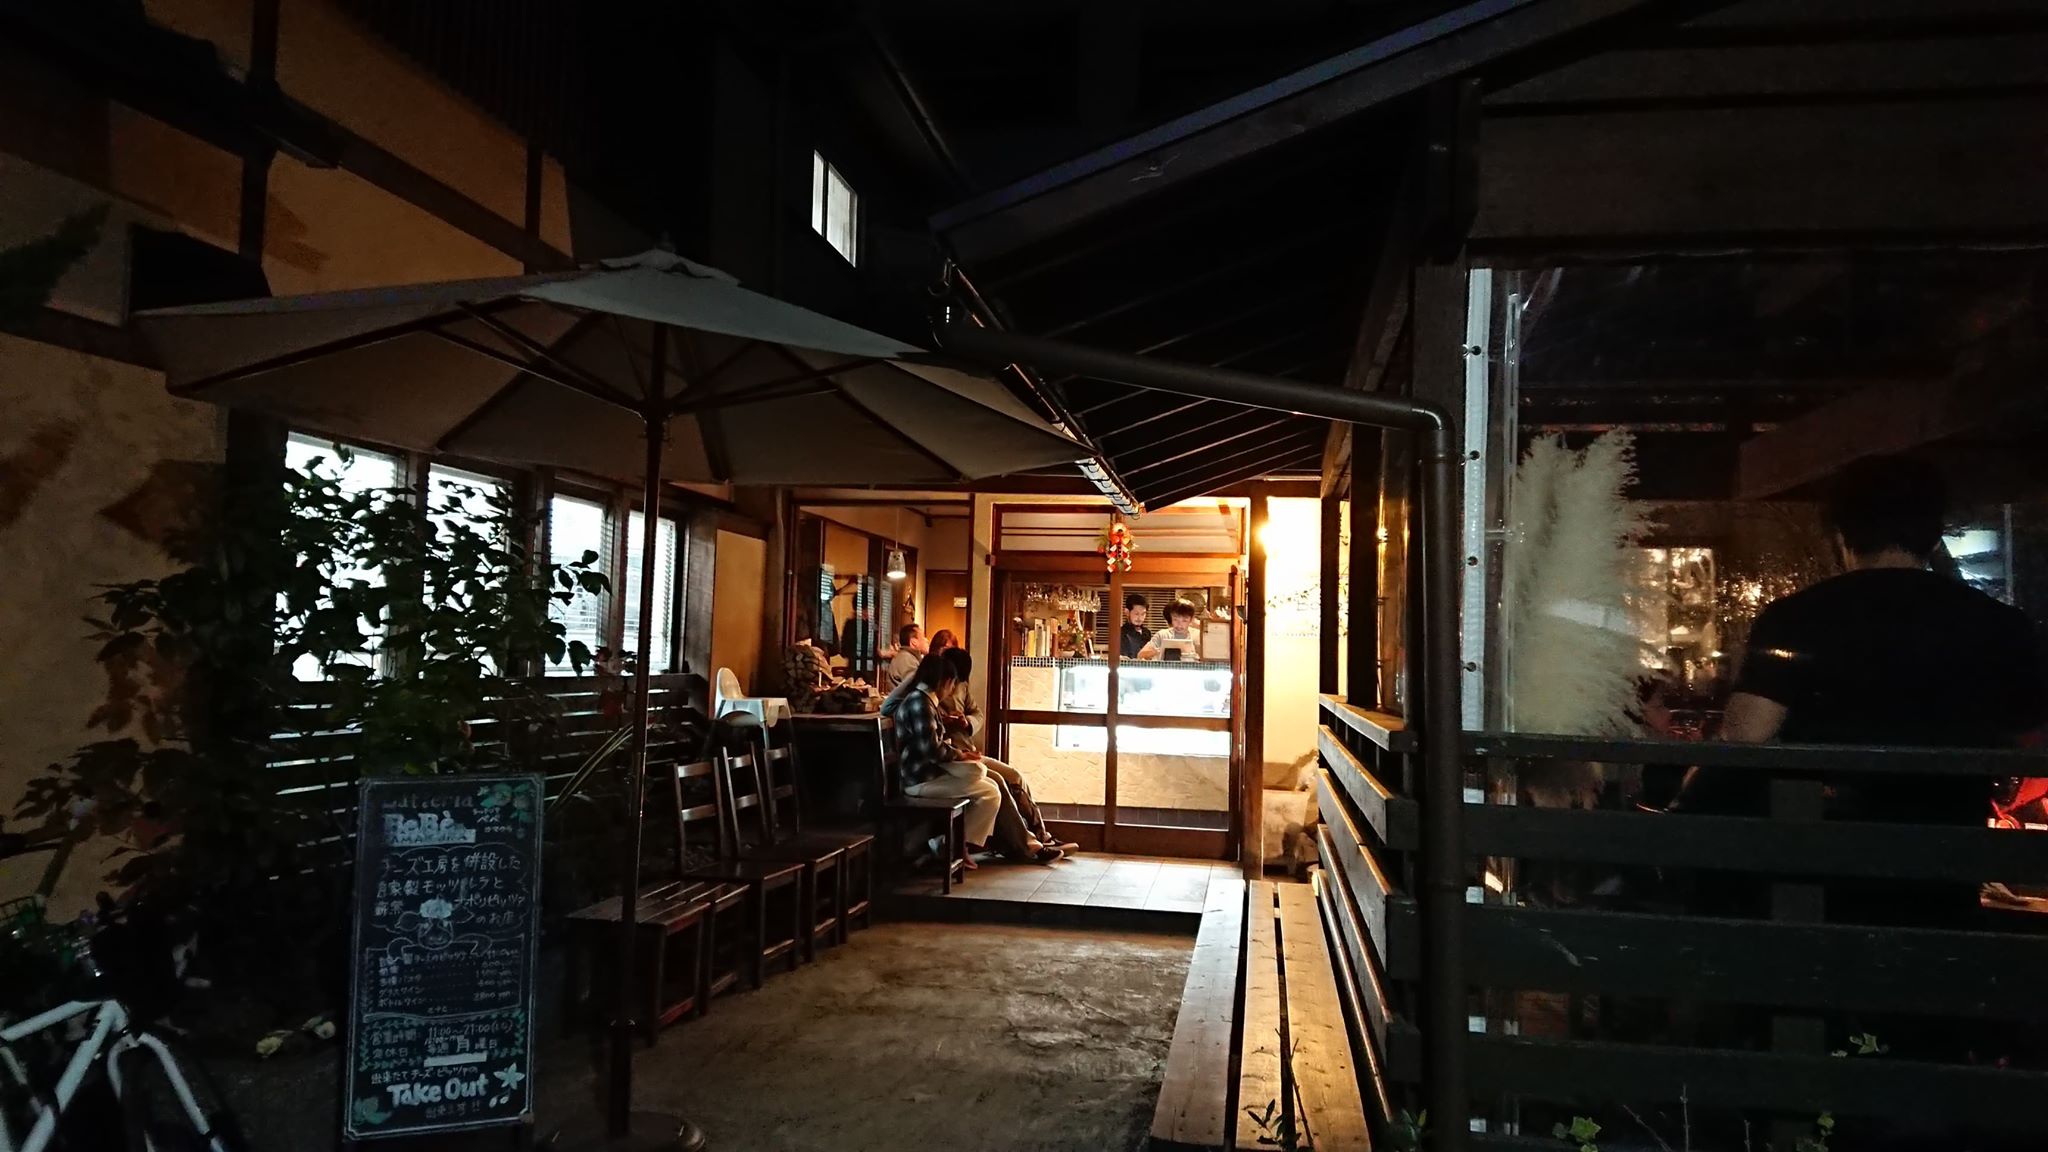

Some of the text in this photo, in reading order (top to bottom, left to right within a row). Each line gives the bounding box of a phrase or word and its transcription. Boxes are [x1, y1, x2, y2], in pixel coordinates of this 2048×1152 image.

[382, 851, 521, 878] チーズ工房を併設した
[376, 876, 504, 899] 自家製モッツレラと
[386, 1073, 489, 1108] Take Out
